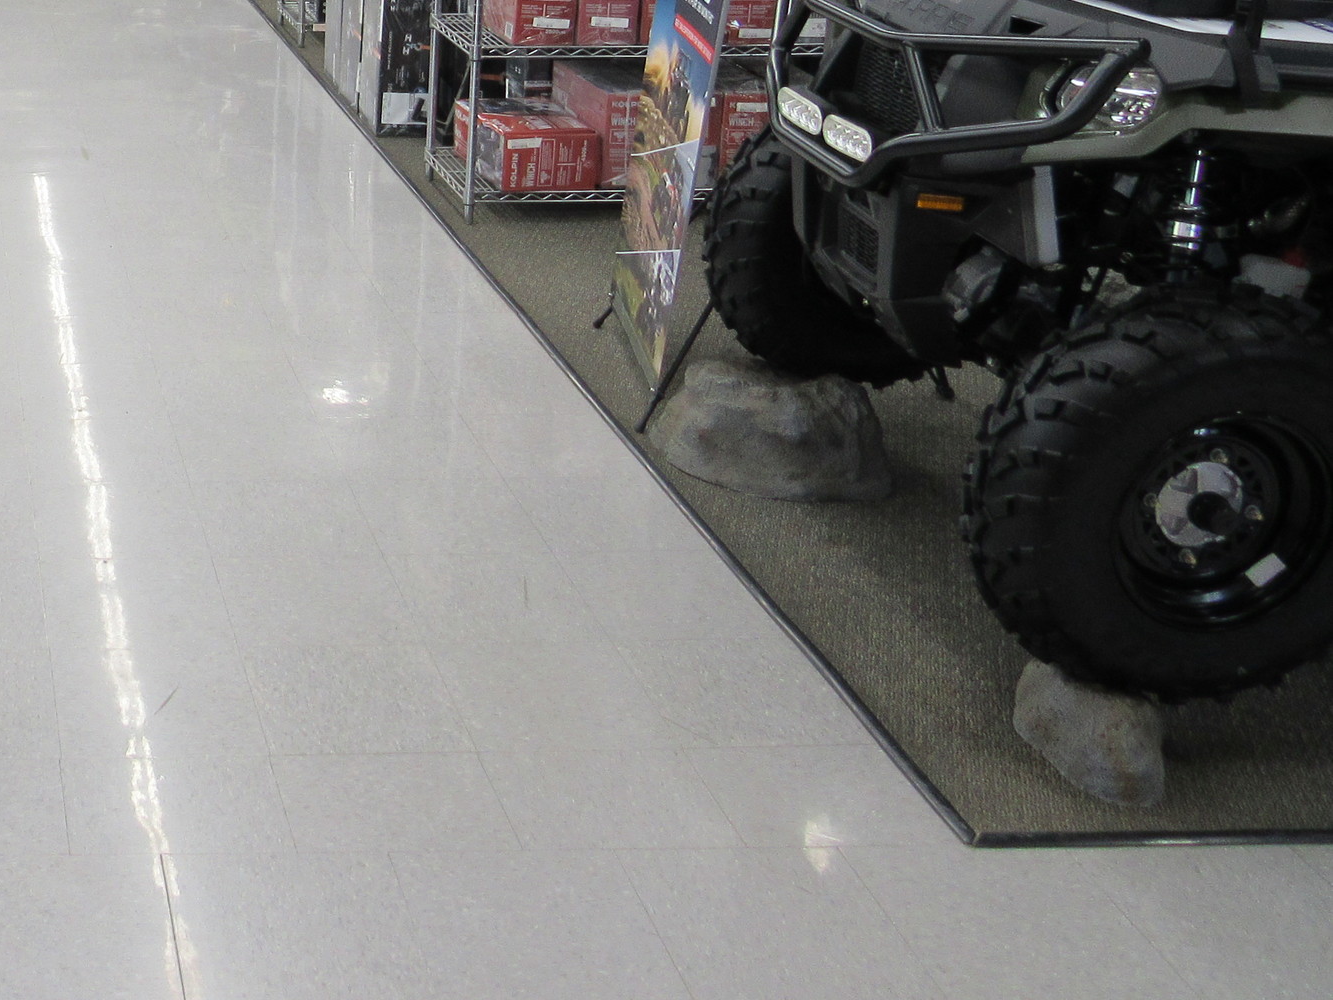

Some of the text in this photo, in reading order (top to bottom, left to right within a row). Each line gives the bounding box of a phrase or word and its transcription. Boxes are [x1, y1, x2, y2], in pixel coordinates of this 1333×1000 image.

[611, 117, 636, 126] WINCH
[509, 152, 519, 188] KOLPIN
[526, 162, 535, 187] WINCH
